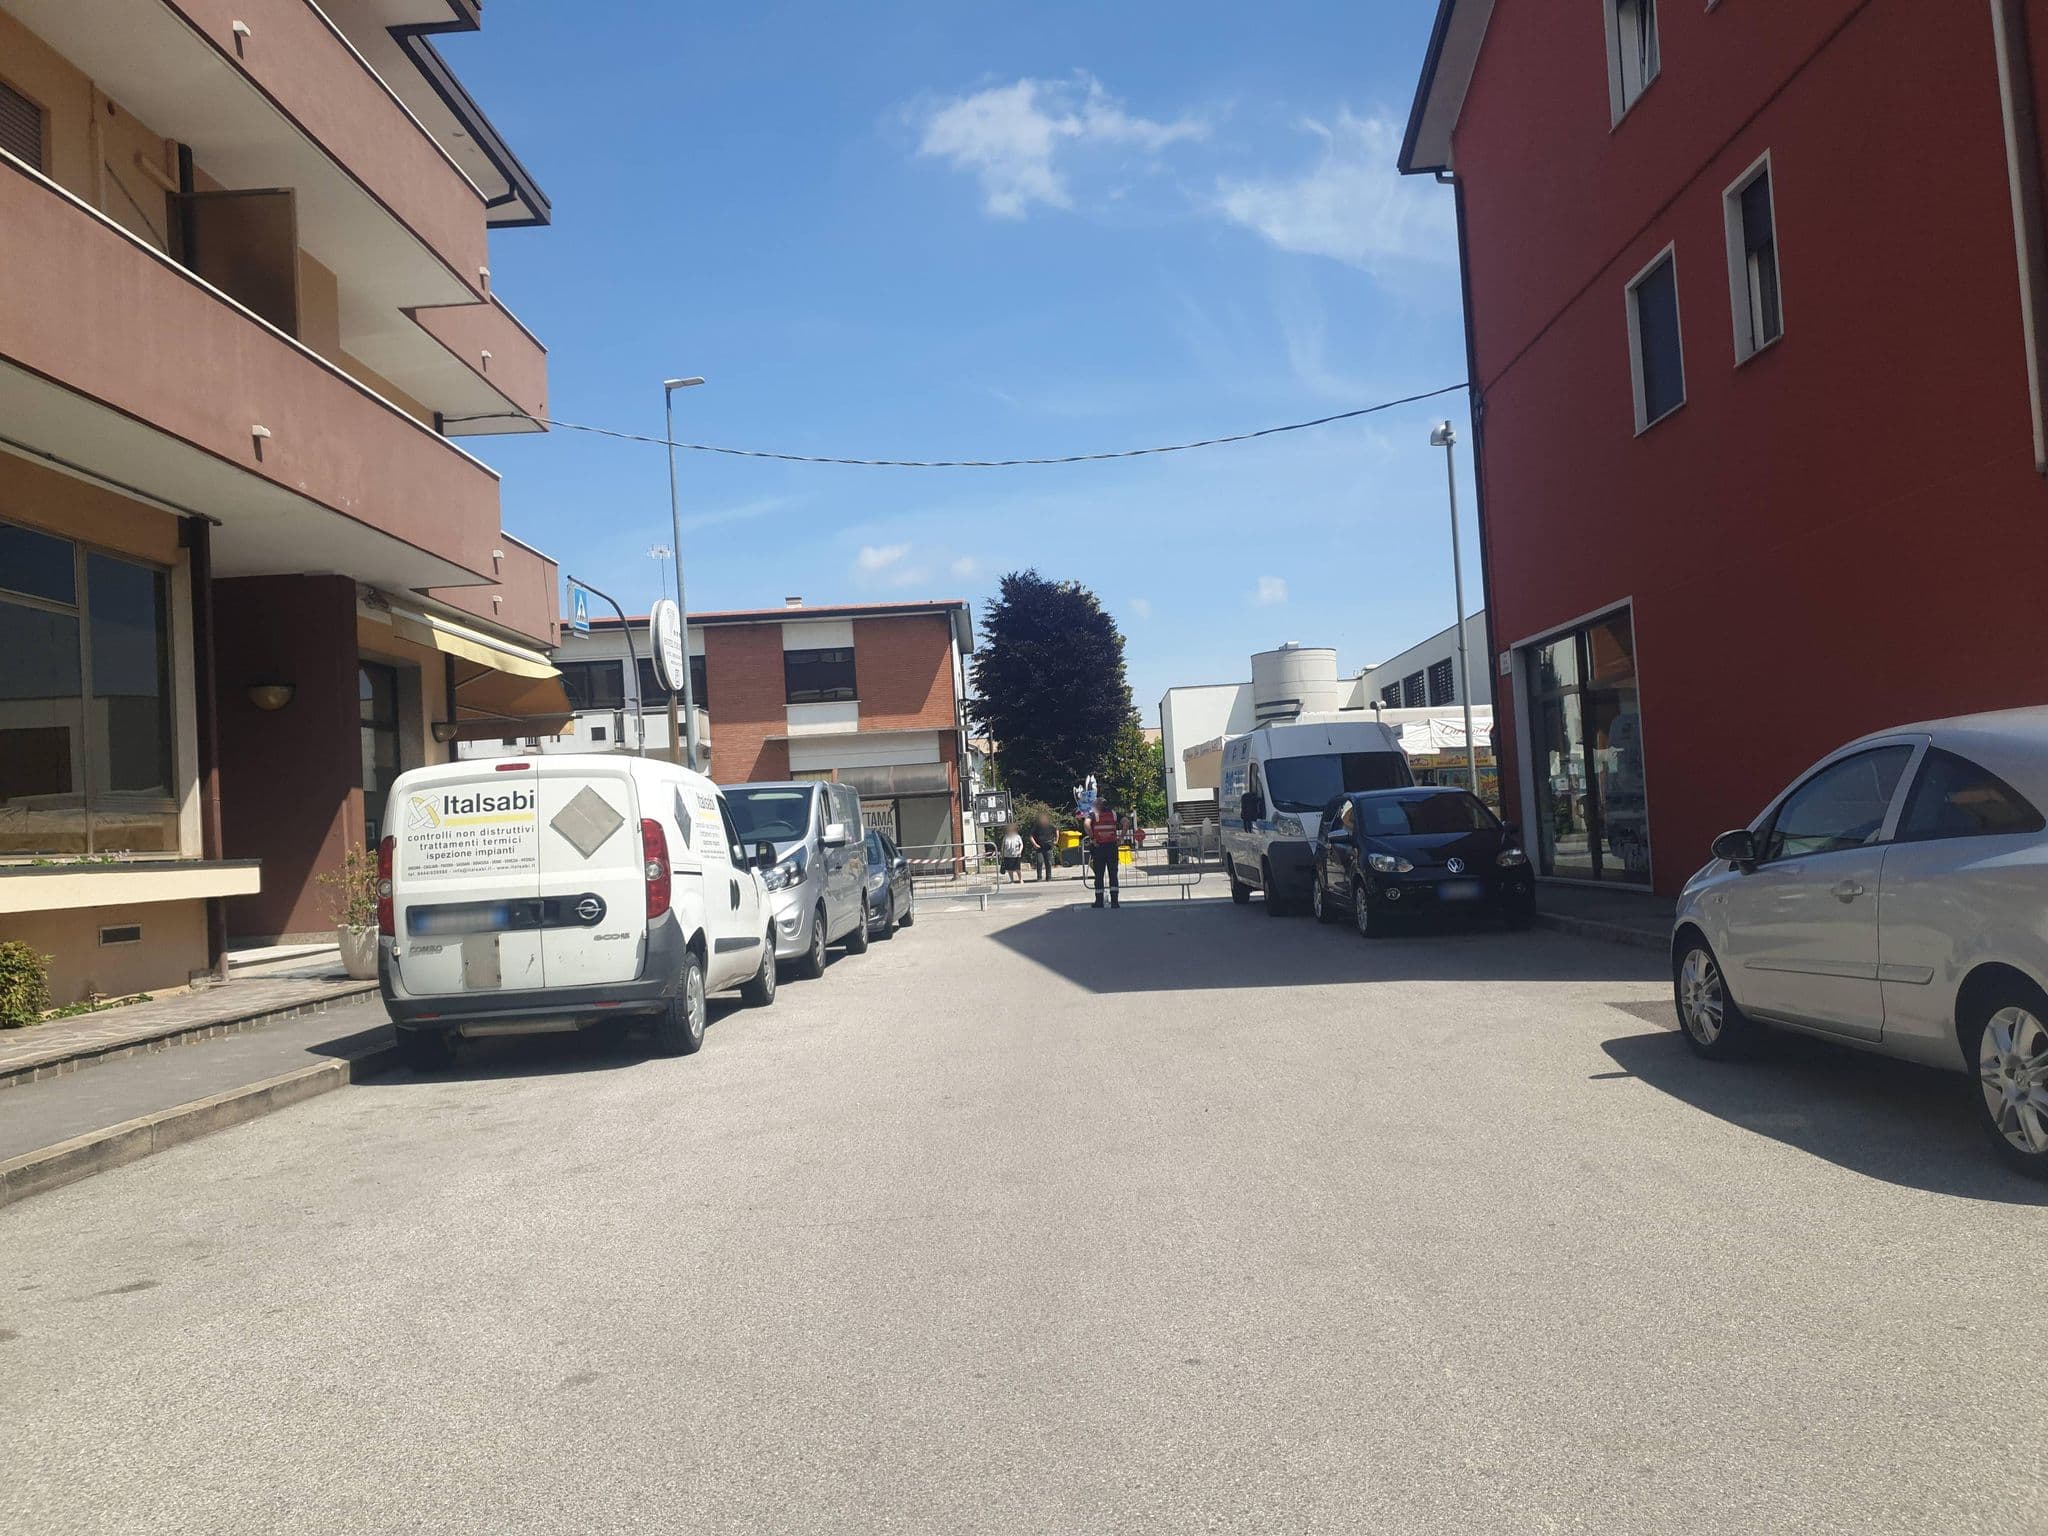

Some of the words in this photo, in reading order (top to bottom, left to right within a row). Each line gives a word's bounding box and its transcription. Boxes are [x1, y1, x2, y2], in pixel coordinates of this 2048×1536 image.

[444, 789, 535, 815] Italsabi
[407, 831, 452, 842] controlli
[456, 829, 476, 838] non
[480, 826, 535, 836] distruttivi
[420, 838, 479, 850] trattamenti
[483, 836, 522, 845] termici
[426, 850, 472, 861] ispezione
[475, 846, 515, 857] impianti
